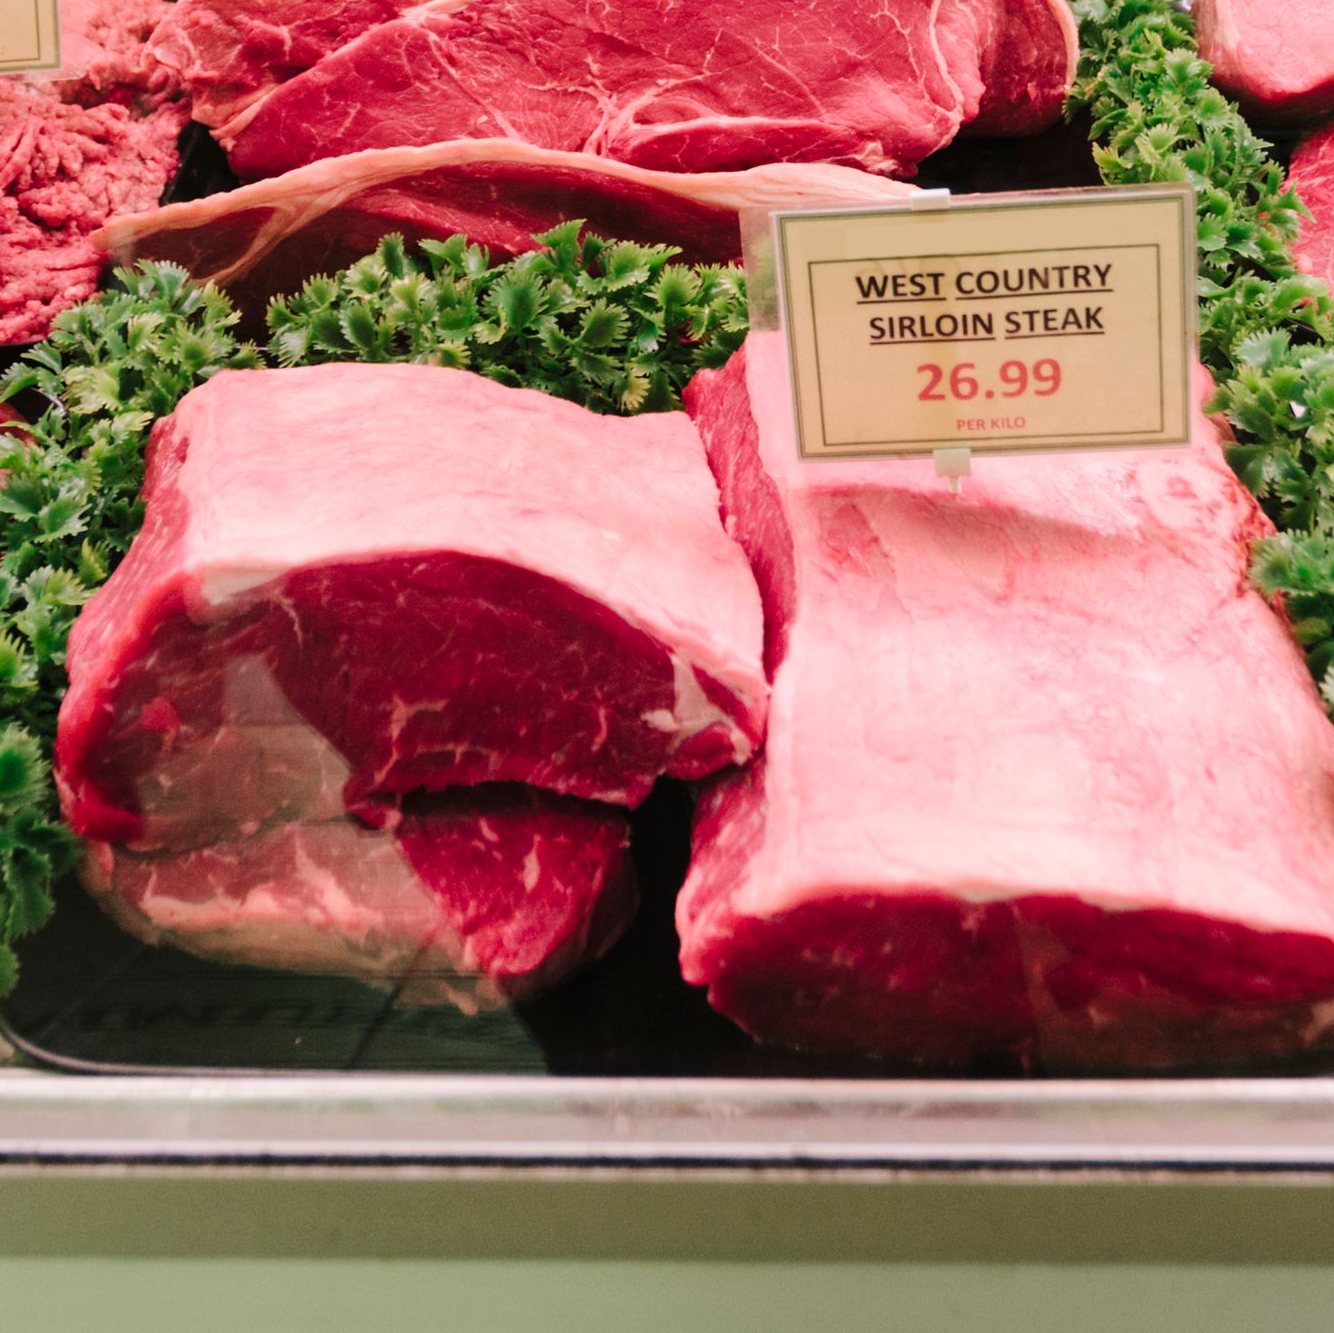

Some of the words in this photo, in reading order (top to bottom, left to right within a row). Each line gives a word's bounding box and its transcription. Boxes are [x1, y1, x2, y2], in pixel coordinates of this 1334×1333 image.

[855, 273, 945, 299] WEST
[954, 264, 1113, 295] COUNTRY
[869, 313, 994, 340] SIRLOIN
[1004, 307, 1104, 334] STEAK
[916, 358, 1063, 403] 26.99
[956, 418, 986, 432] PER
[990, 416, 1026, 430] KILO
